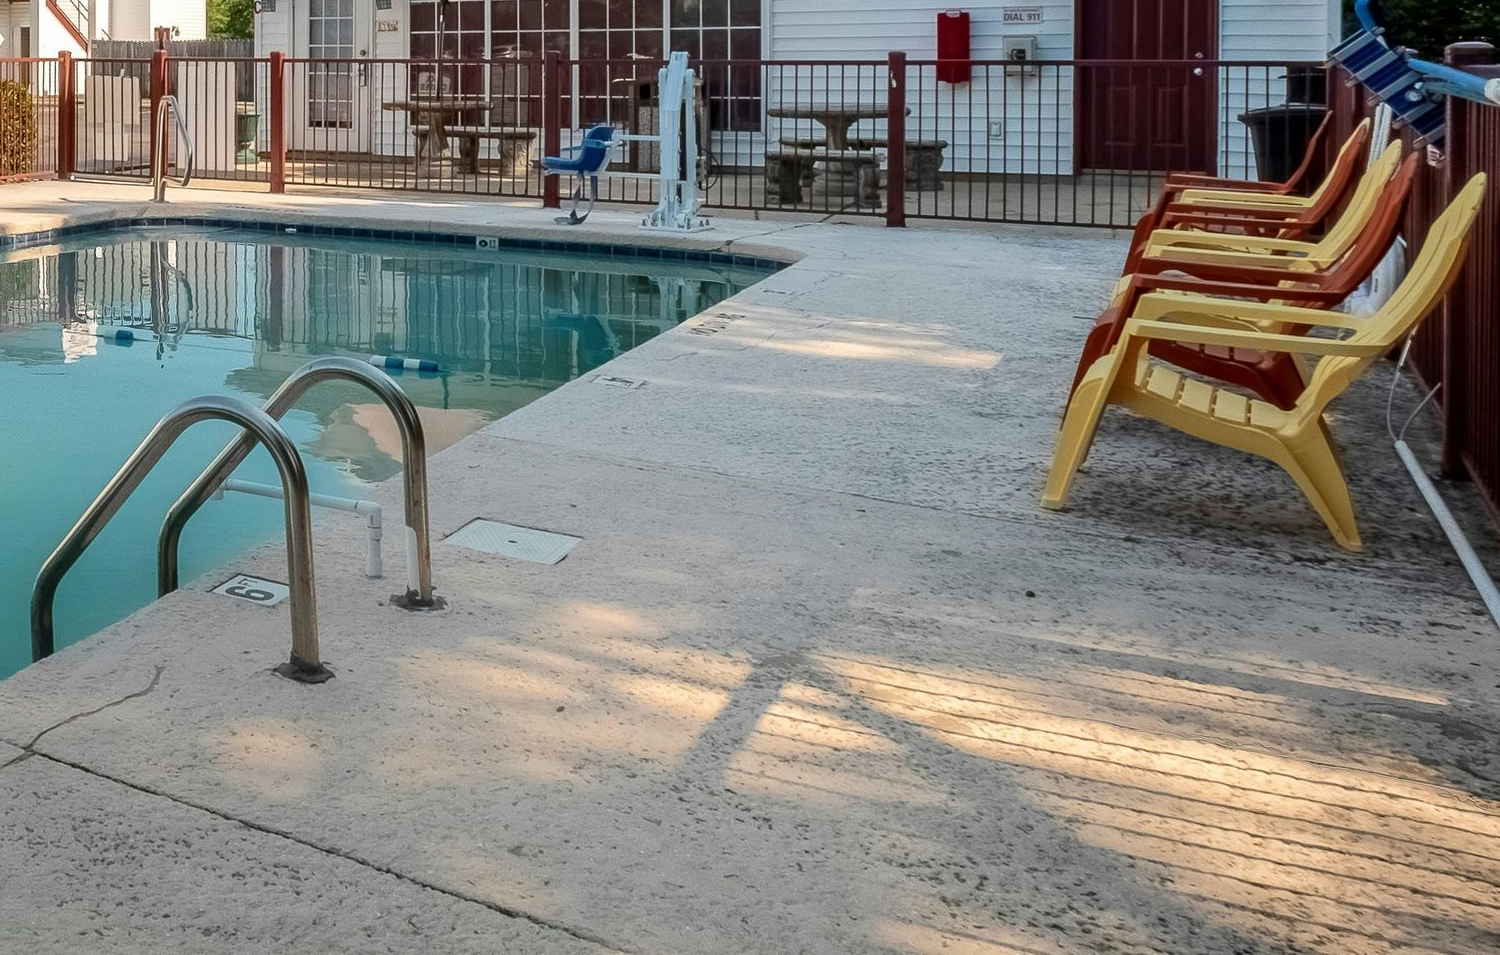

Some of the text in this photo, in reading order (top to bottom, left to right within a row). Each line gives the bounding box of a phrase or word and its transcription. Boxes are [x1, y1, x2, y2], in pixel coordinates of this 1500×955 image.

[1003, 12, 1041, 22] DIAL 911
[224, 585, 276, 601] 6
